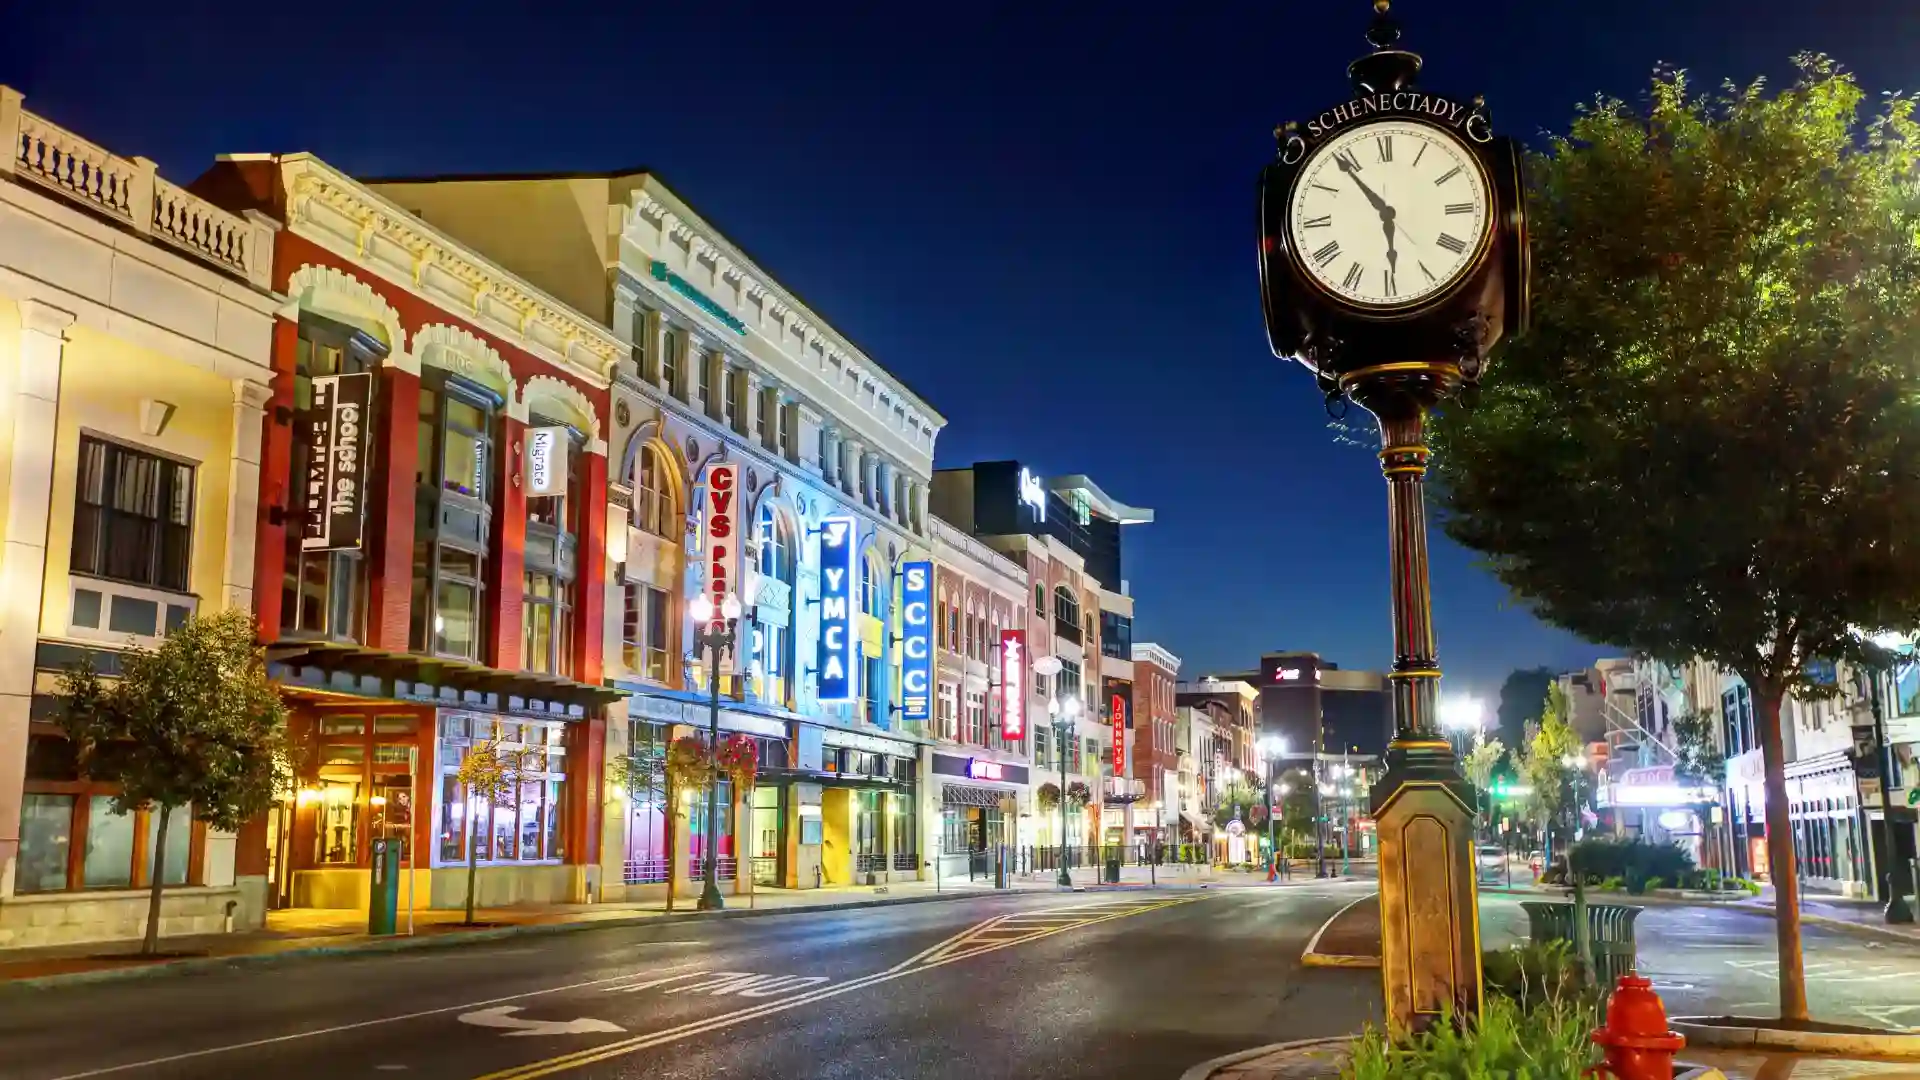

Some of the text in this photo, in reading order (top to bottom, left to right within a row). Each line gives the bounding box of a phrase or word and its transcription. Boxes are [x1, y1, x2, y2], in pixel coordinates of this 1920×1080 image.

[1307, 92, 1464, 137] SCHENECTADY
[1375, 135, 1393, 163] XII
[1434, 165, 1462, 187] II
[1444, 202, 1474, 215] III
[331, 402, 360, 515] the school
[532, 432, 549, 486] Migrate
[710, 467, 733, 539] CVS
[823, 567, 846, 679] YMCA
[904, 568, 927, 693] SCCC
